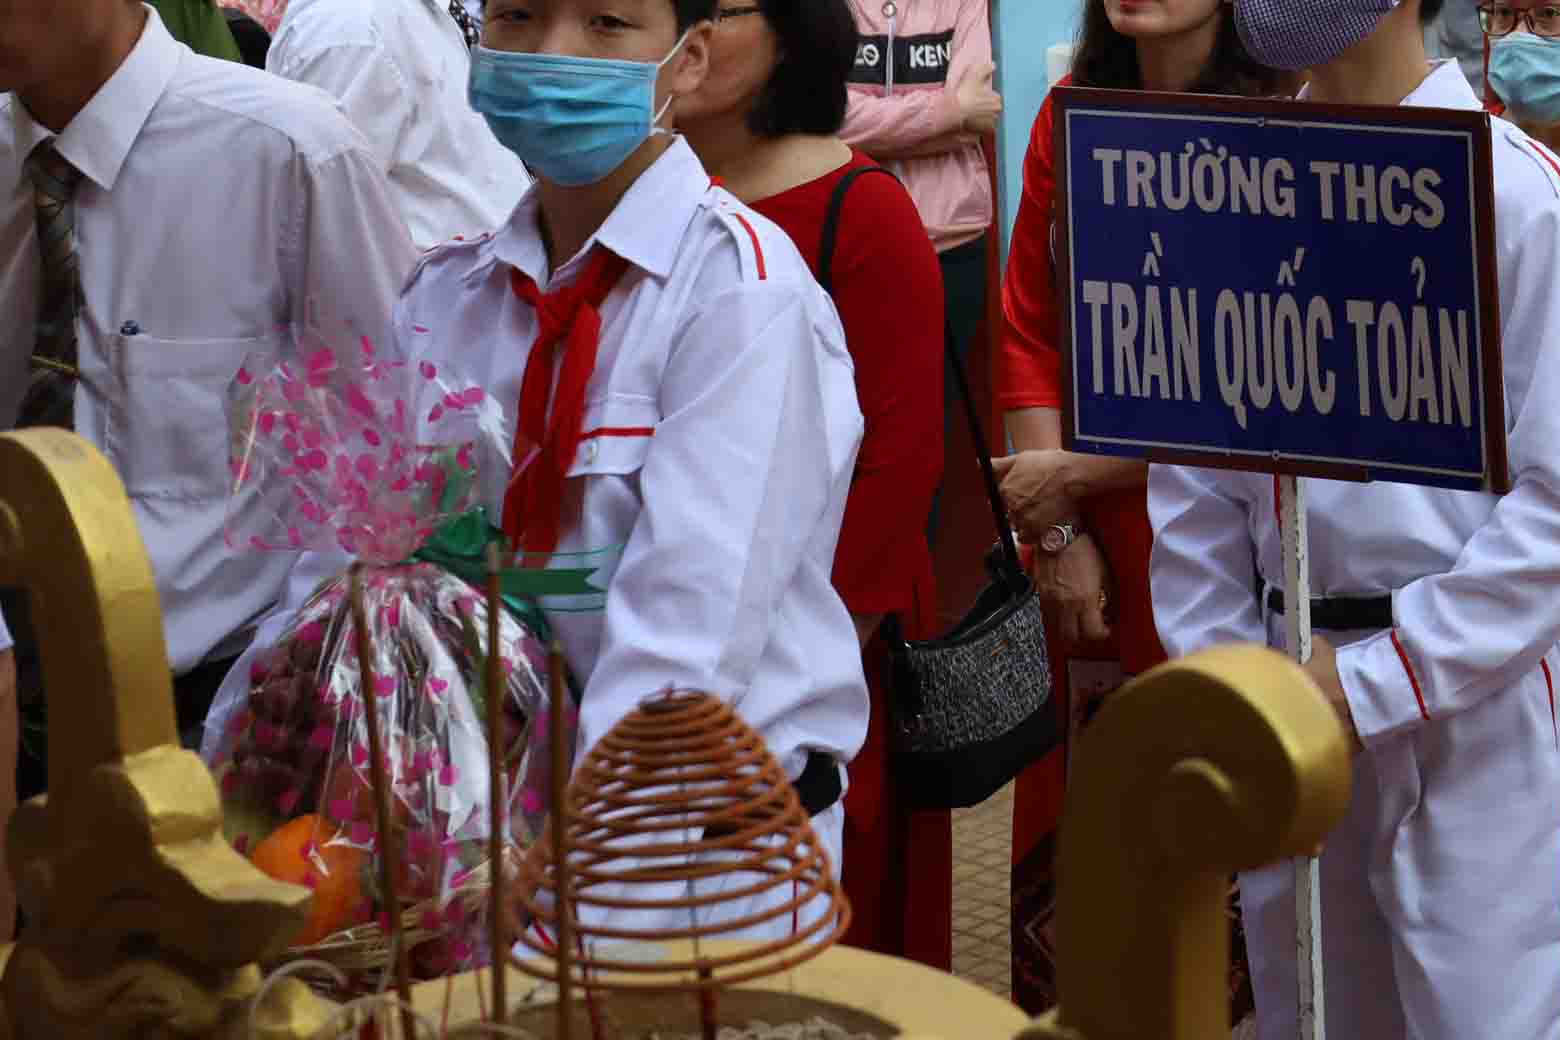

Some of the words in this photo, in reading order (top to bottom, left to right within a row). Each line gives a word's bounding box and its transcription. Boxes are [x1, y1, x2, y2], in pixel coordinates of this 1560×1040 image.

[1092, 137, 1297, 218] TRƯỜNG
[1310, 160, 1445, 229] THCS
[1082, 232, 1202, 403] TRẦN
[1214, 246, 1336, 430] QUỐC
[1344, 255, 1473, 428] TOẢN
